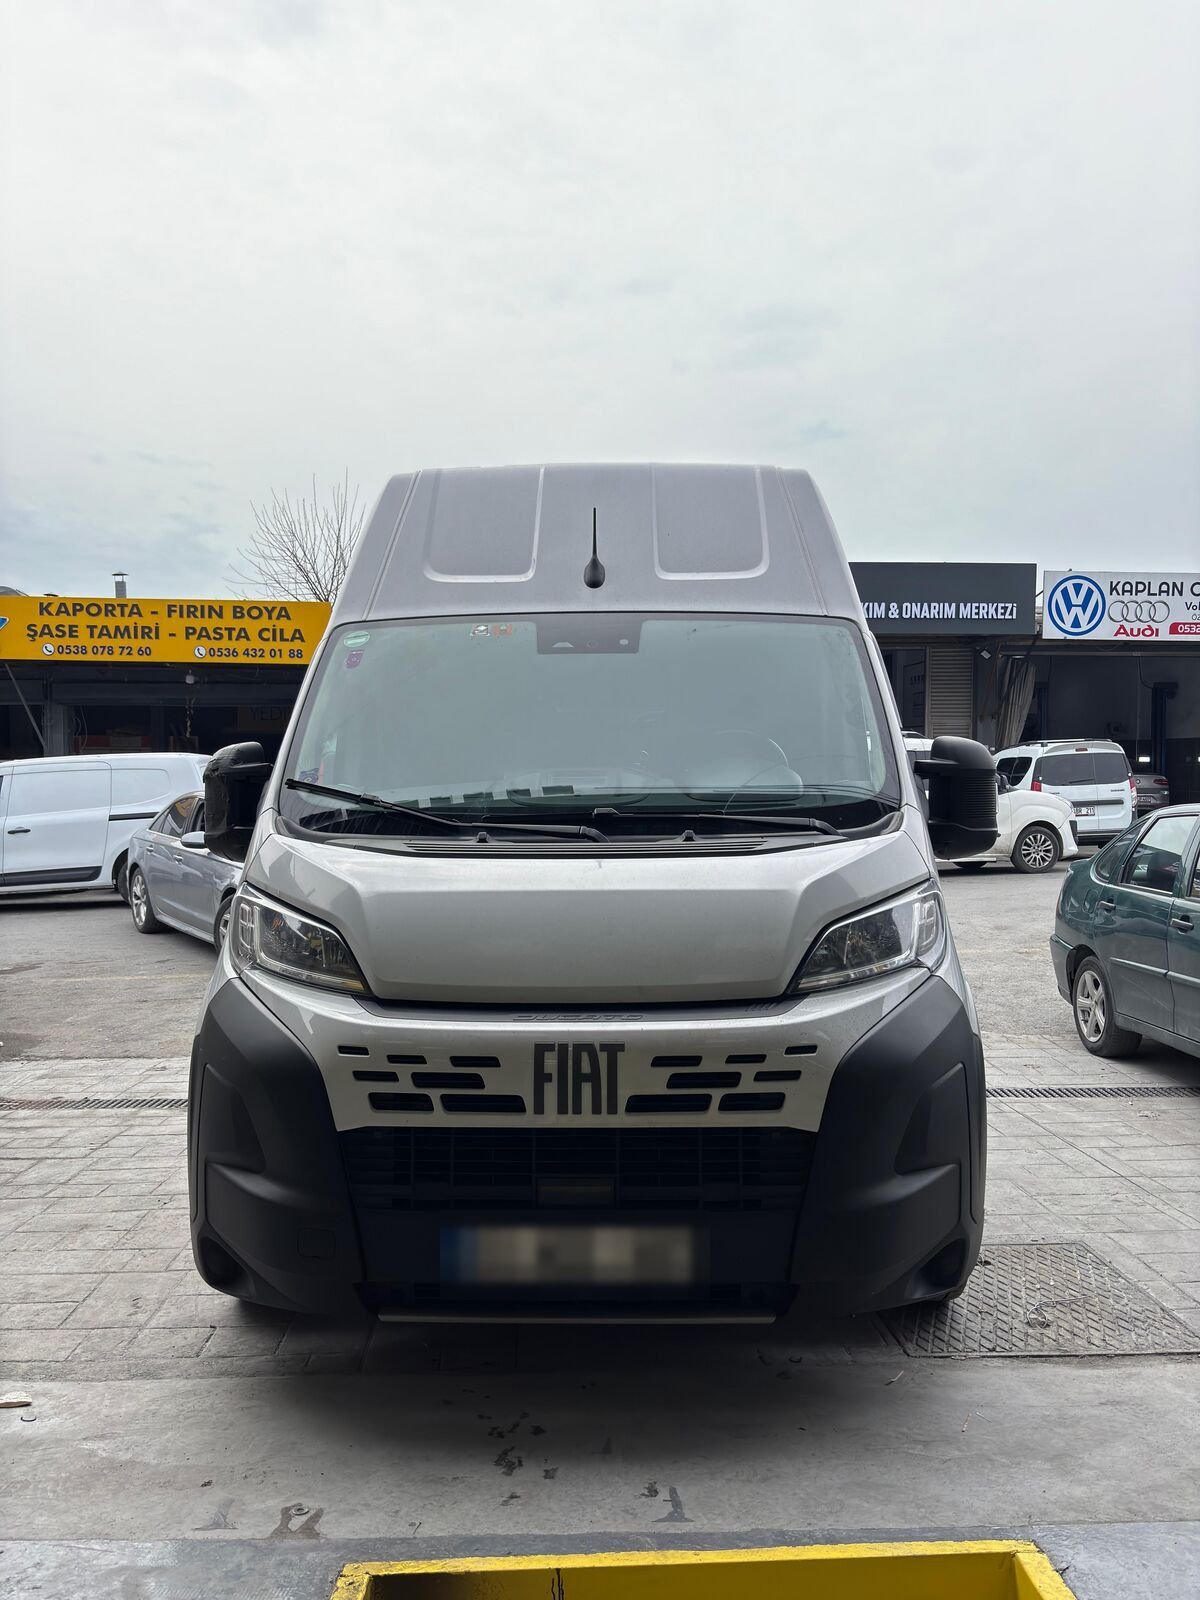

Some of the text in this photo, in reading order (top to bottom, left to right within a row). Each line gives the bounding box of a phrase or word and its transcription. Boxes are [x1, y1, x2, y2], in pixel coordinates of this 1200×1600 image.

[1109, 580, 1184, 597] KAPLAN
[38, 601, 144, 618] KAPORTA
[166, 603, 224, 620] FIRIN
[232, 604, 292, 621] BOYA
[888, 602, 900, 619] &
[902, 602, 956, 619] ONARIM
[26, 623, 80, 642] ŞASE
[86, 621, 160, 640] TAMİRİ
[184, 626, 252, 642] PASTA
[257, 624, 306, 643] CİLA
[56, 644, 153, 657] 0538 078 72 60
[208, 647, 304, 660] 0536 432 01 88
[533, 1042, 626, 1116] FIAT
